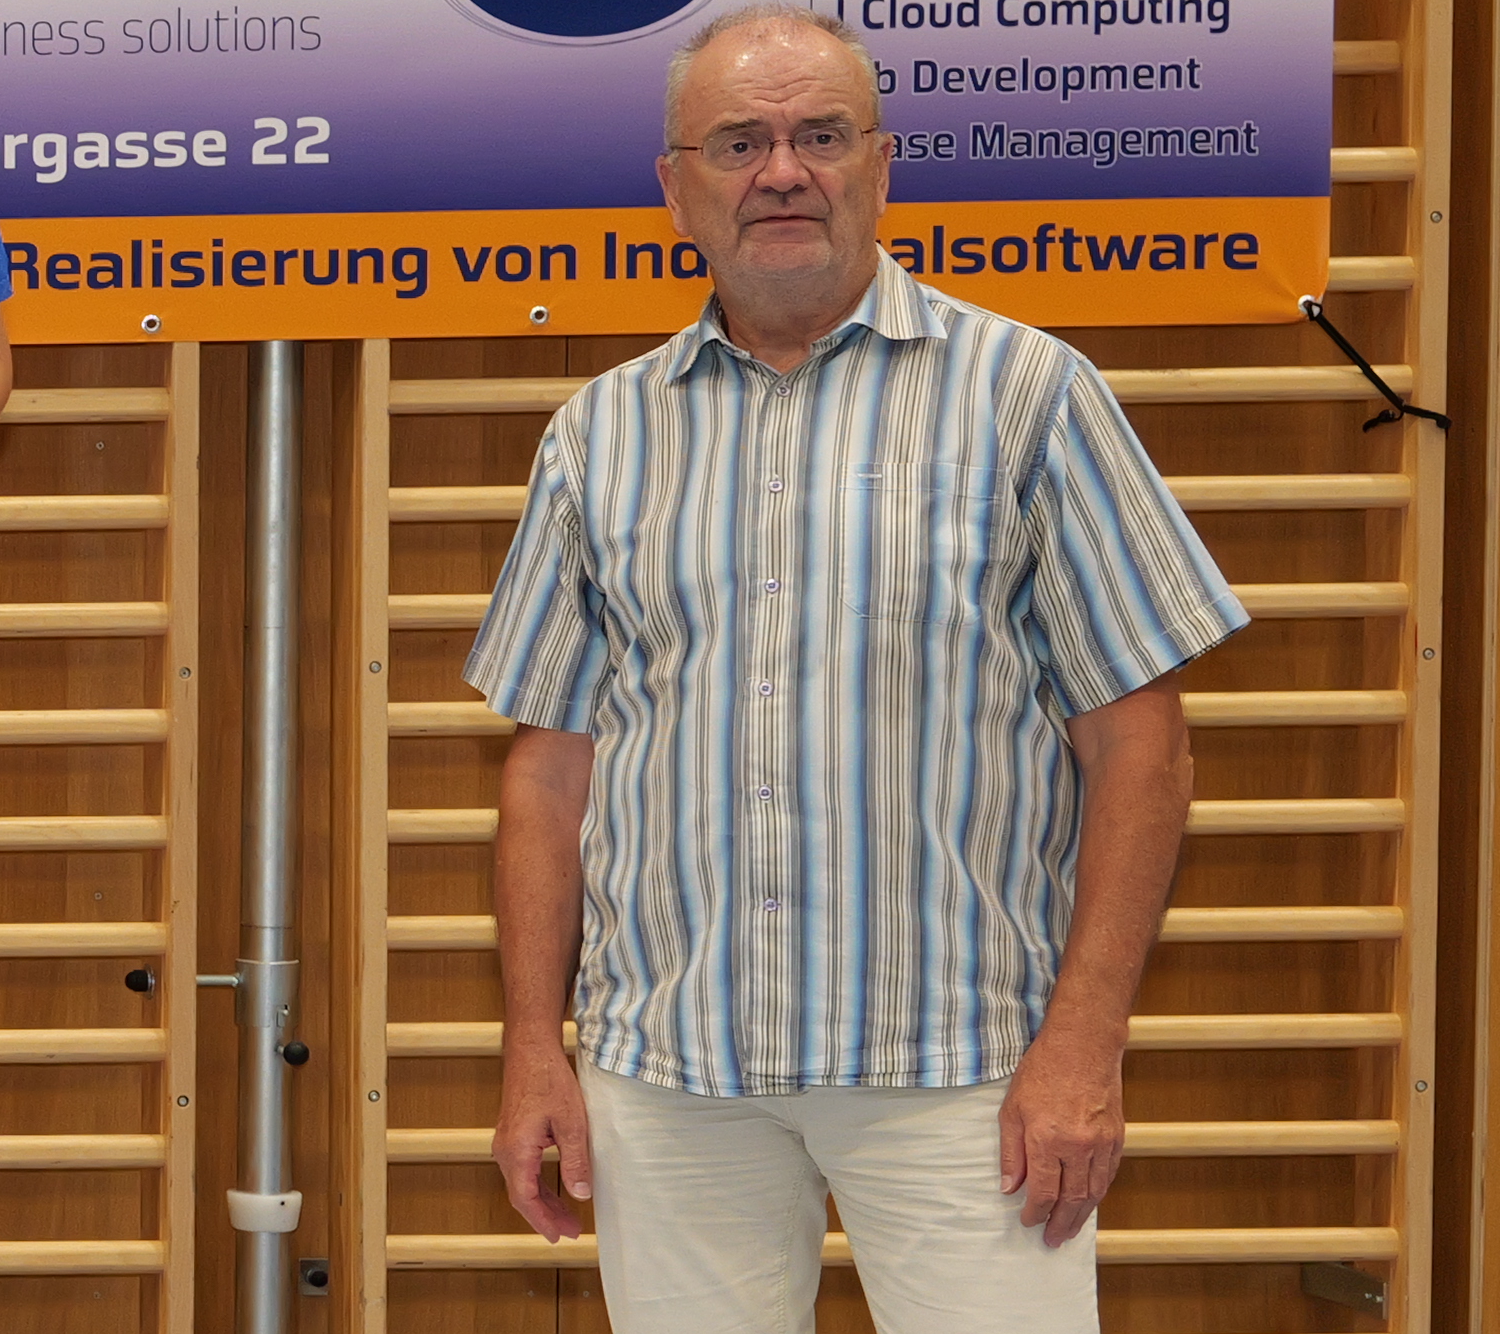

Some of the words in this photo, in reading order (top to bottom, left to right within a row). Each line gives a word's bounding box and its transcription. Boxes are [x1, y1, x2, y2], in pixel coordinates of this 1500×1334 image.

[122, 6, 323, 55] solutions
[911, 56, 1202, 103] Development
[251, 116, 332, 166] 22
[969, 121, 1260, 168] Management
[2, 238, 429, 299] Realisierung
[452, 242, 577, 283] von
